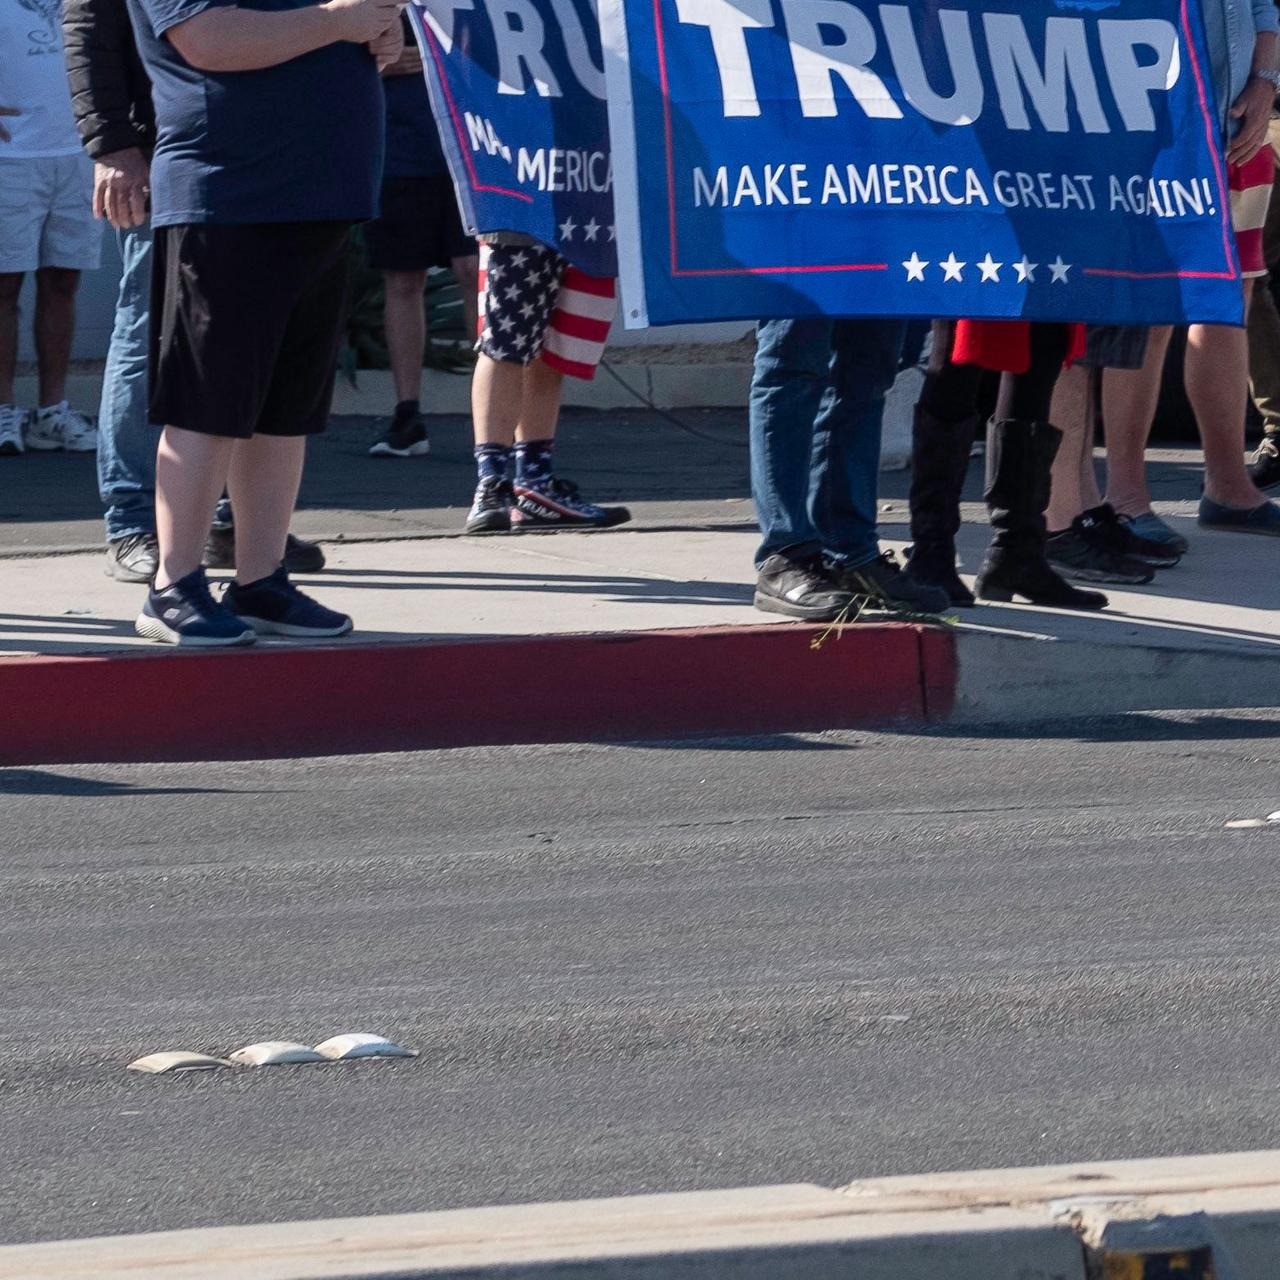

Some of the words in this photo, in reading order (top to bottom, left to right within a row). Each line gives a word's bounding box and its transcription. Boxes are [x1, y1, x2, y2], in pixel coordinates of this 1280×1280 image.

[516, 146, 614, 193] MERIC
[692, 163, 812, 208] MAKE
[820, 163, 990, 206] AMERICA
[993, 170, 1096, 212] GREAT
[1108, 174, 1217, 218] AGAIN!
